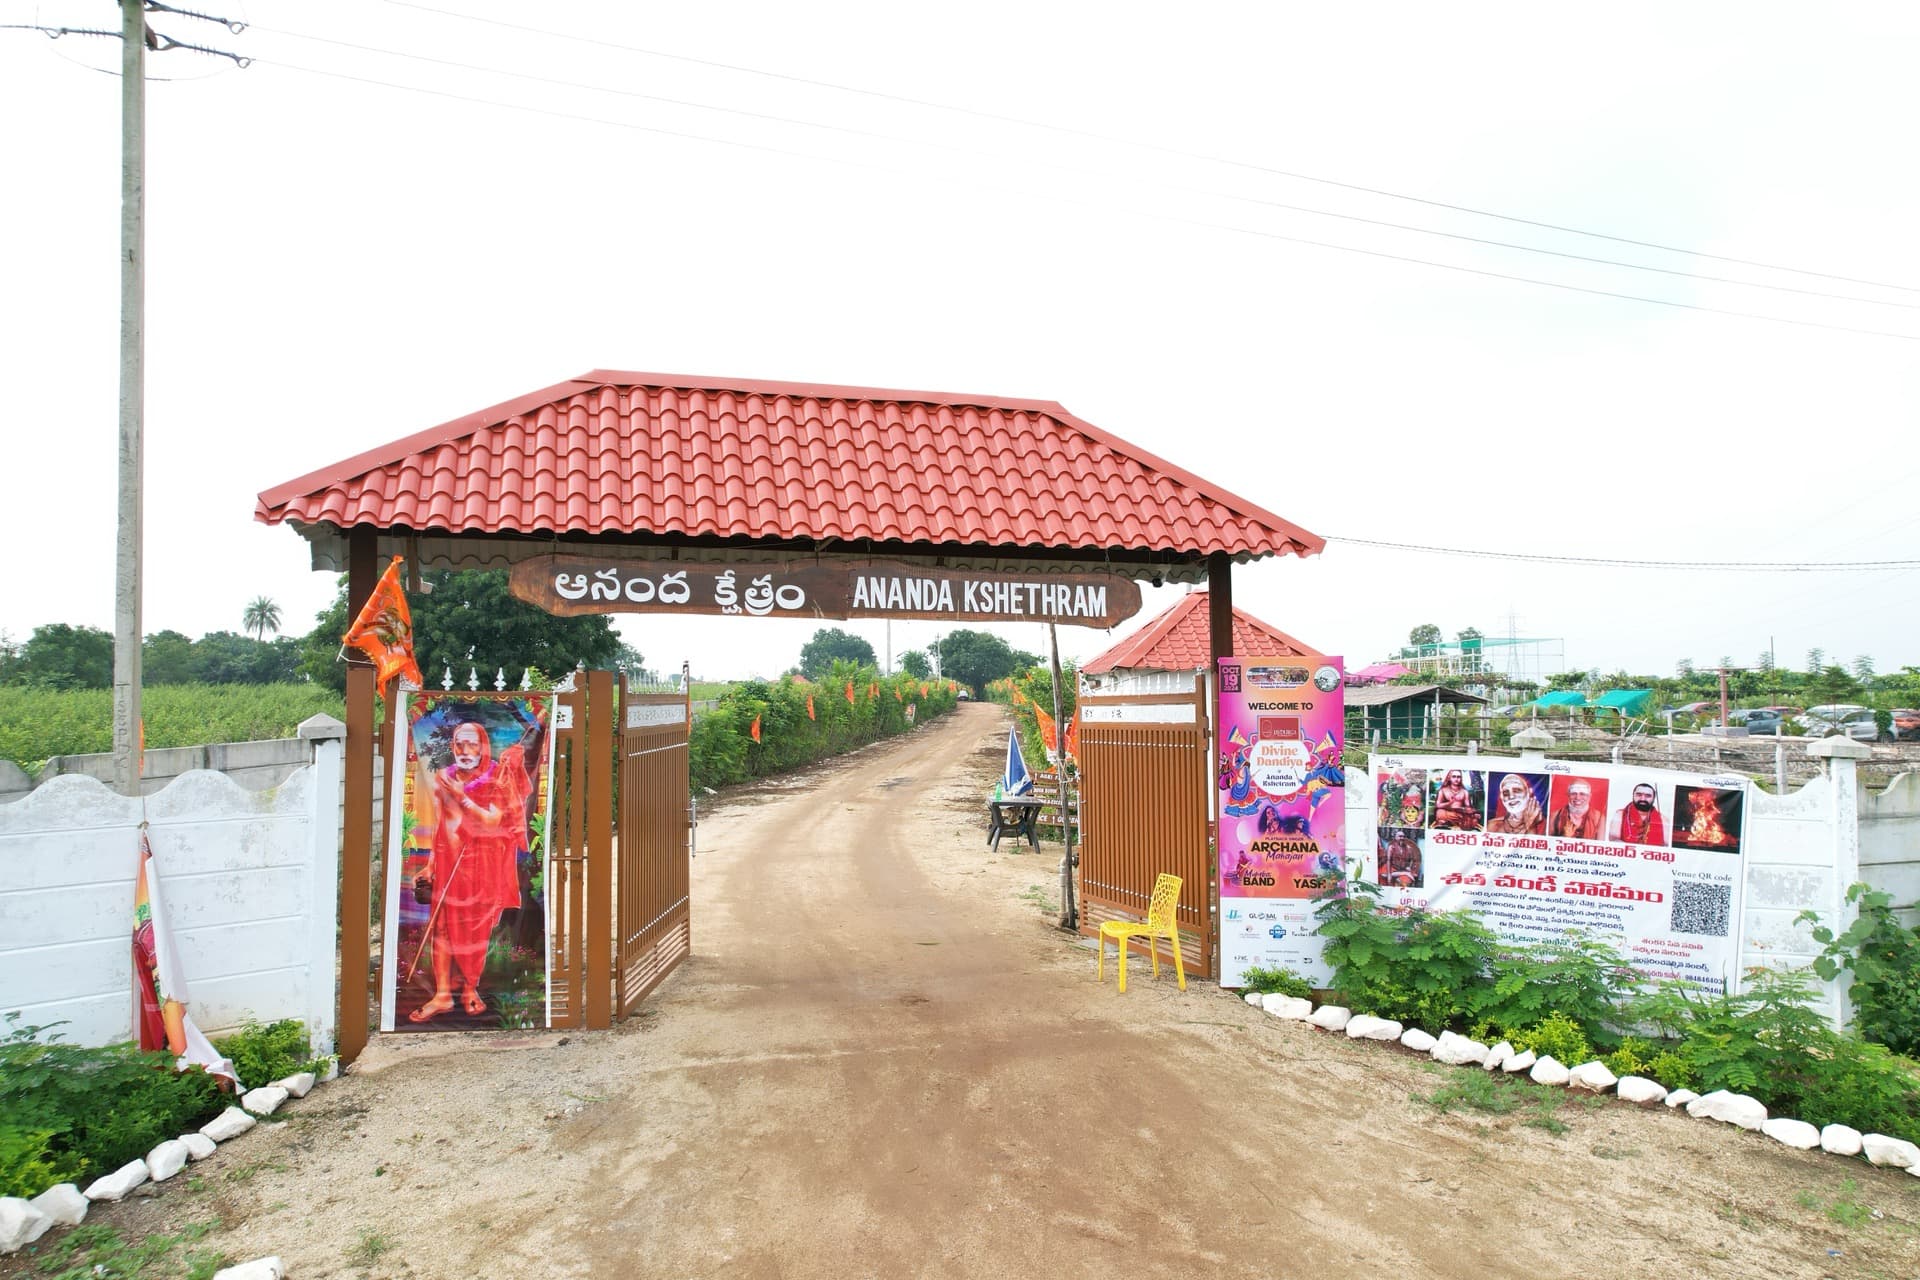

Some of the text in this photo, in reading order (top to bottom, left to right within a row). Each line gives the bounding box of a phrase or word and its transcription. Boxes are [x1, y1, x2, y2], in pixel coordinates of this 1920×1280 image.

[554, 568, 806, 616] ఆనంద క్షేత్రం
[852, 576, 1108, 618] ANANDA KSHETHRAM
[1222, 666, 1240, 674] OCT
[1223, 674, 1239, 685] 19
[1248, 702, 1314, 711] WELCOME TO
[1261, 745, 1298, 756] Divine
[1256, 756, 1303, 769] Dandiya
[1251, 842, 1319, 853] ARCHANA
[1432, 832, 1478, 847] శంకర
[1482, 832, 1506, 848] సేవ
[1555, 840, 1637, 859] హైదరాబాద్
[1640, 850, 1676, 865] శాఖ
[1265, 851, 1304, 863] Mahajan
[1671, 869, 1733, 882] Venue QR code
[1243, 877, 1276, 887] BAND
[1440, 872, 1487, 887] శత
[1493, 874, 1558, 893] చండీ
[1400, 898, 1415, 906] UPI
